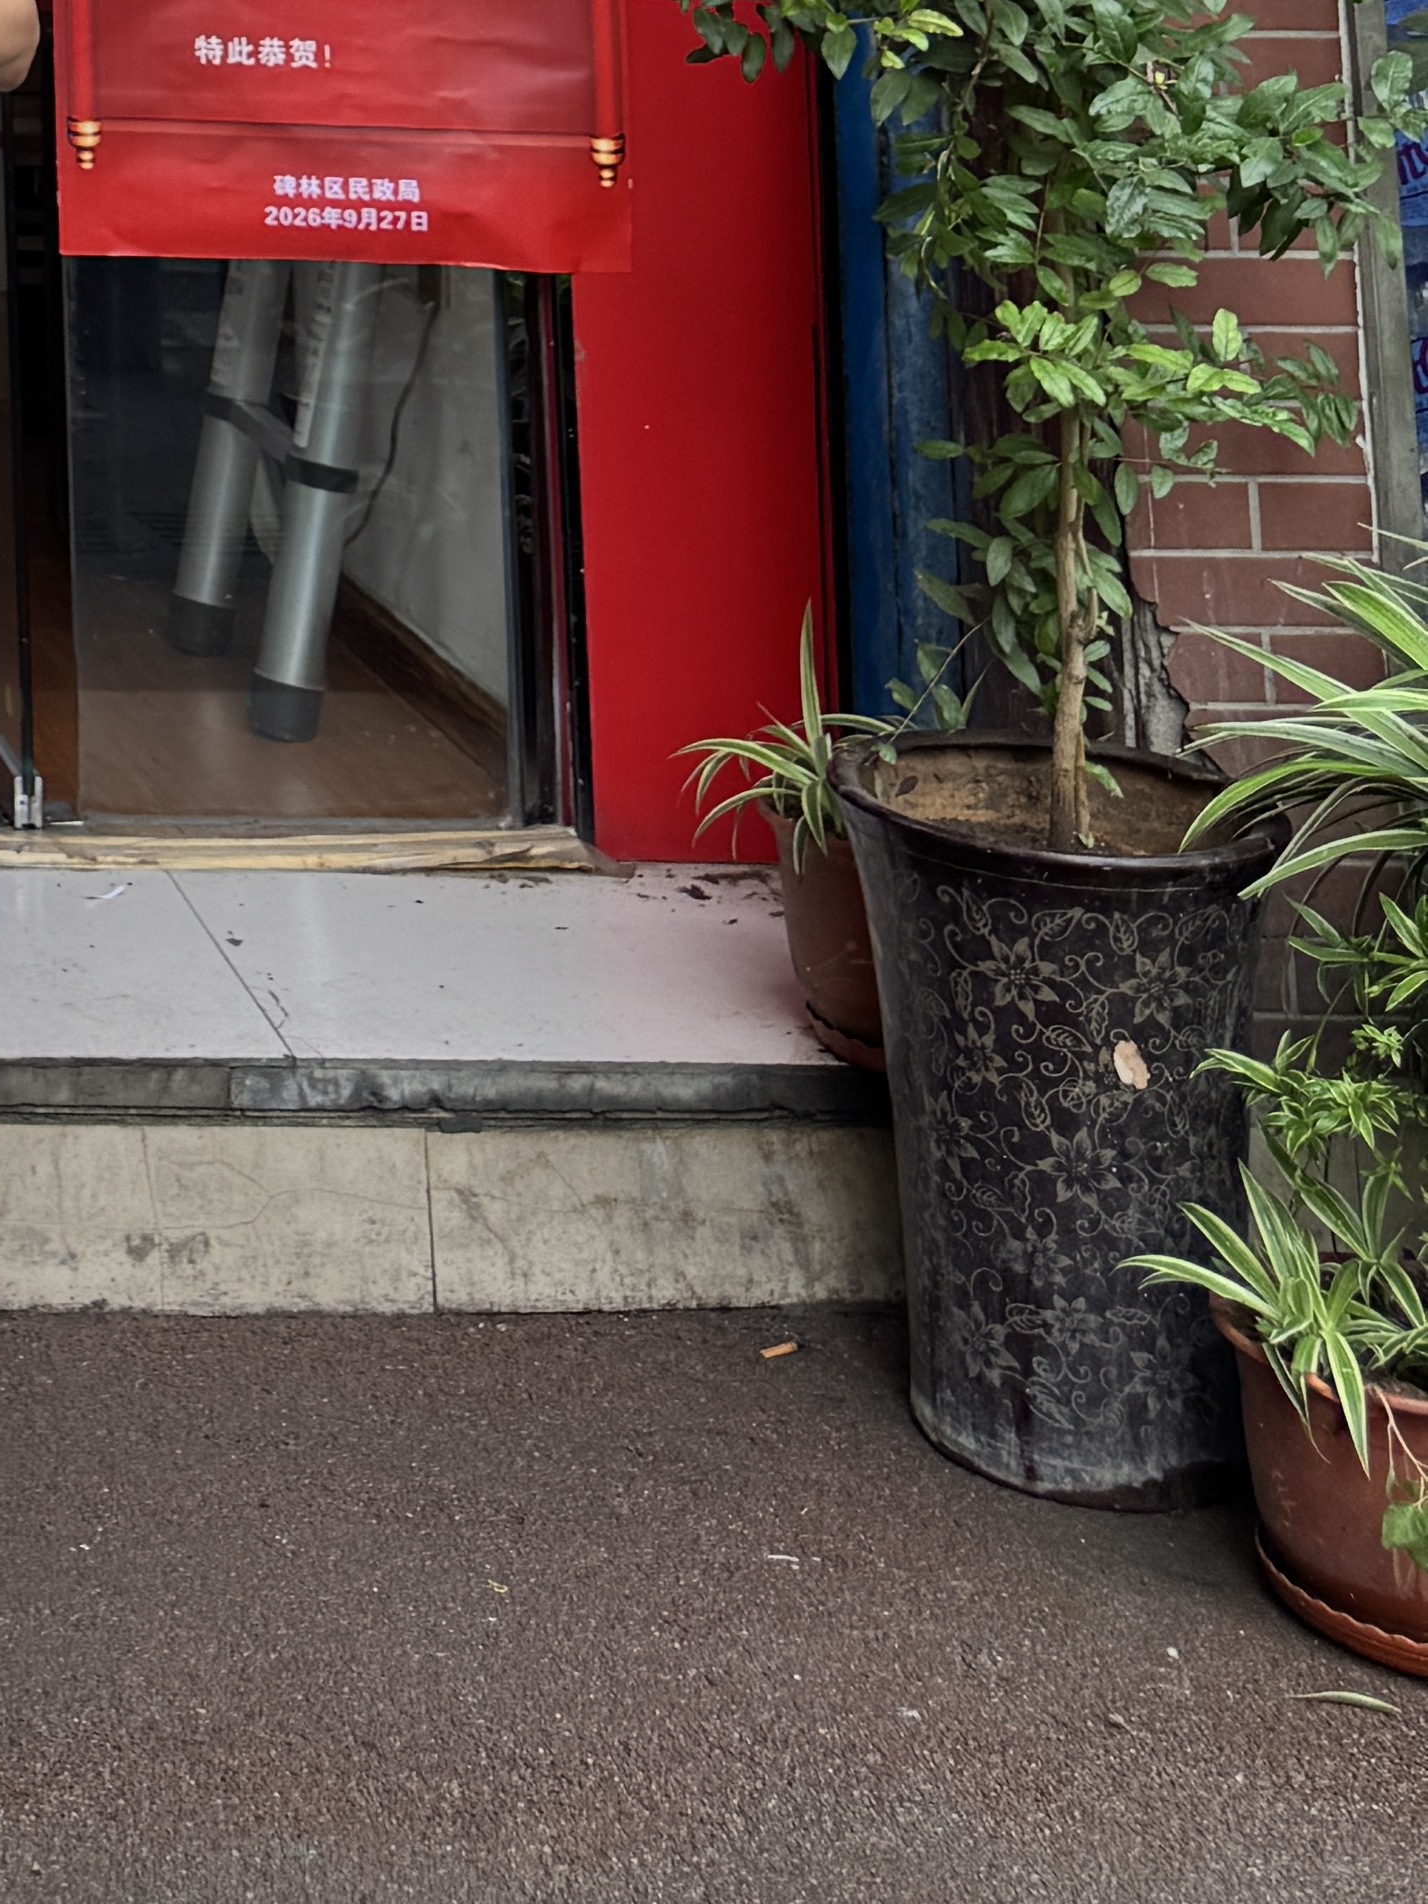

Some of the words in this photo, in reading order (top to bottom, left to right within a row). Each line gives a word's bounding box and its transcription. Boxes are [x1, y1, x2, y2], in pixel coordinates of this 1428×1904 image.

[273, 174, 422, 204] 碑林区民政局
[264, 203, 431, 234] 2026年9月27日
